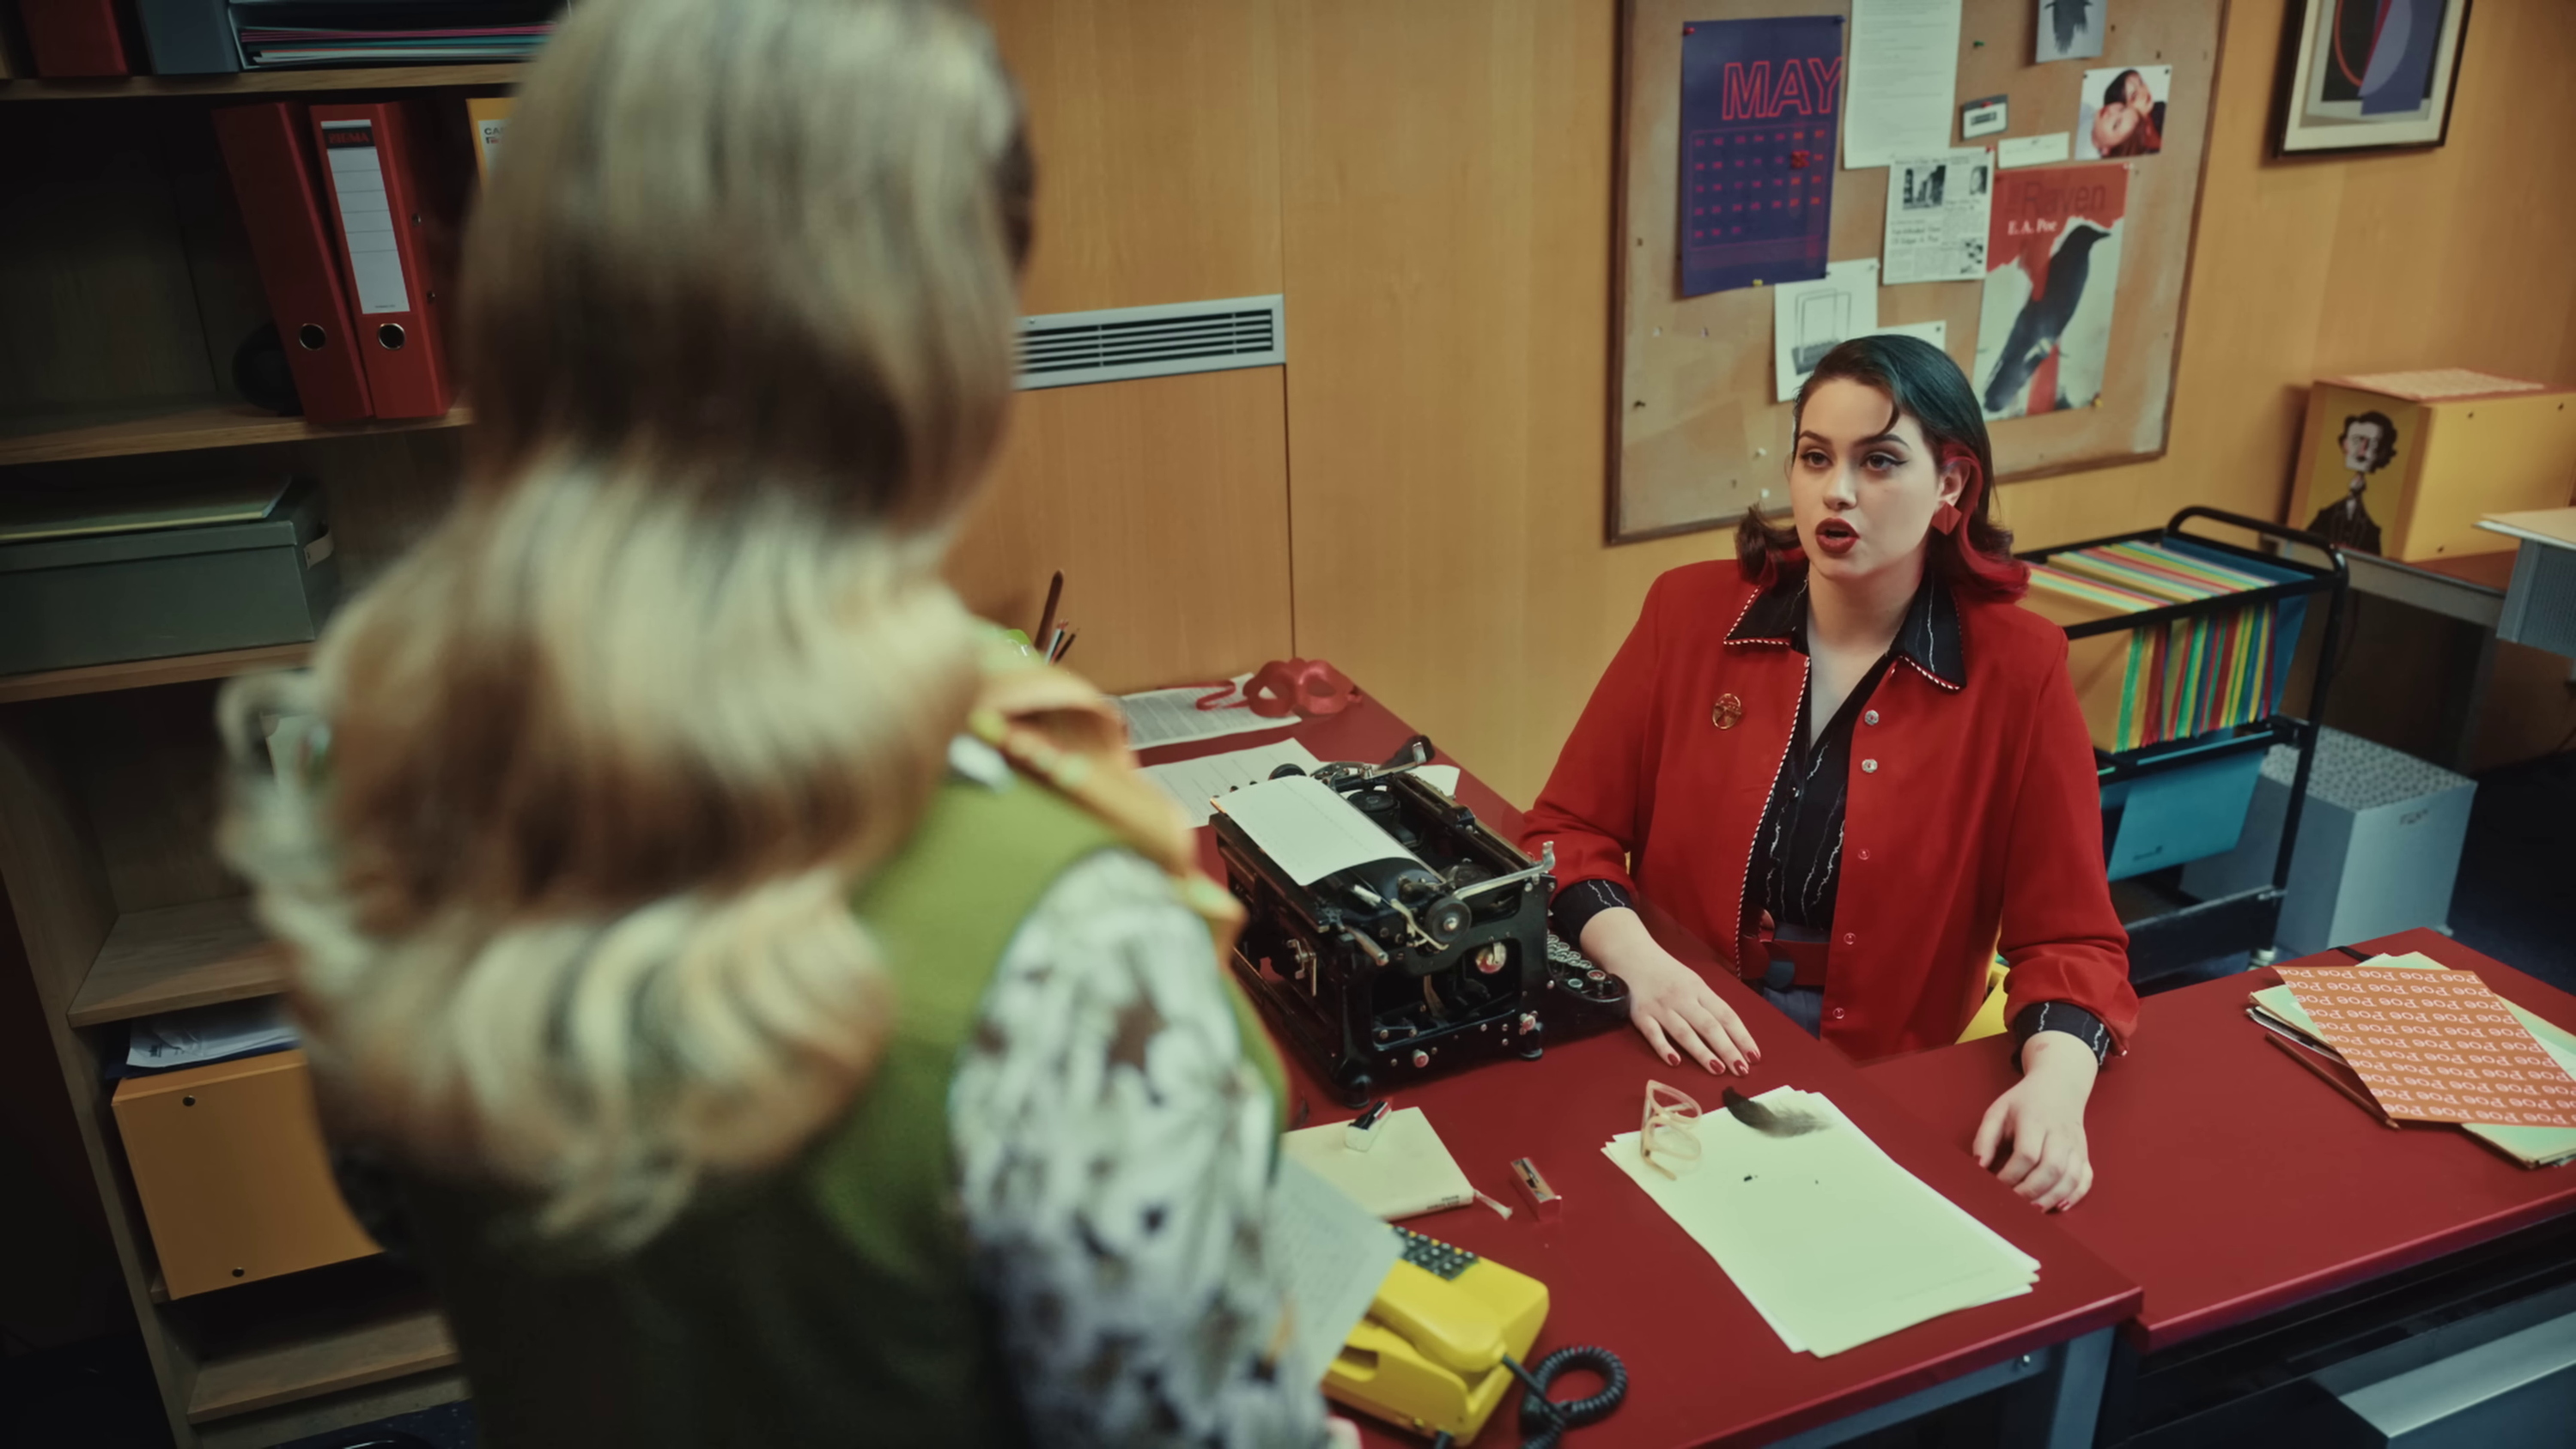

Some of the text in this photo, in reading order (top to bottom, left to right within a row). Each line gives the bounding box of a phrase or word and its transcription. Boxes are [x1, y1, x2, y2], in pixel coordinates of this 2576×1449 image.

[1722, 57, 1842, 120] MAY
[2275, 968, 2482, 985] Poe Poe Poe Poe Poe
[2285, 980, 2494, 997] Poe Poe Poe Poe Poe
[2295, 994, 2506, 1011] Poe Poe Poe Poe Poe
[2306, 1008, 2518, 1025] Poe Poe Poe Poe Poe
[2316, 1022, 2534, 1039] Poe Poe Poe Poe Poe
[2326, 1034, 2547, 1053] Poe Poe Poe Poe Poe
[2336, 1046, 2560, 1068] Poe Poe Poe Poe Poe
[2347, 1058, 2573, 1082] Poe Poe Poe Poe Poe
[2358, 1072, 2403, 1086] Poe
[2403, 1076, 2448, 1090] Poe
[2449, 1081, 2494, 1094] Poe
[2369, 1088, 2415, 1101] Poe
[2494, 1083, 2541, 1095] Poe
[2415, 1091, 2461, 1105] Poe
[2462, 1094, 2507, 1108] Poe
[2508, 1098, 2555, 1111] Poe
[2381, 1103, 2570, 1125] Poe Poe Poe Poe
